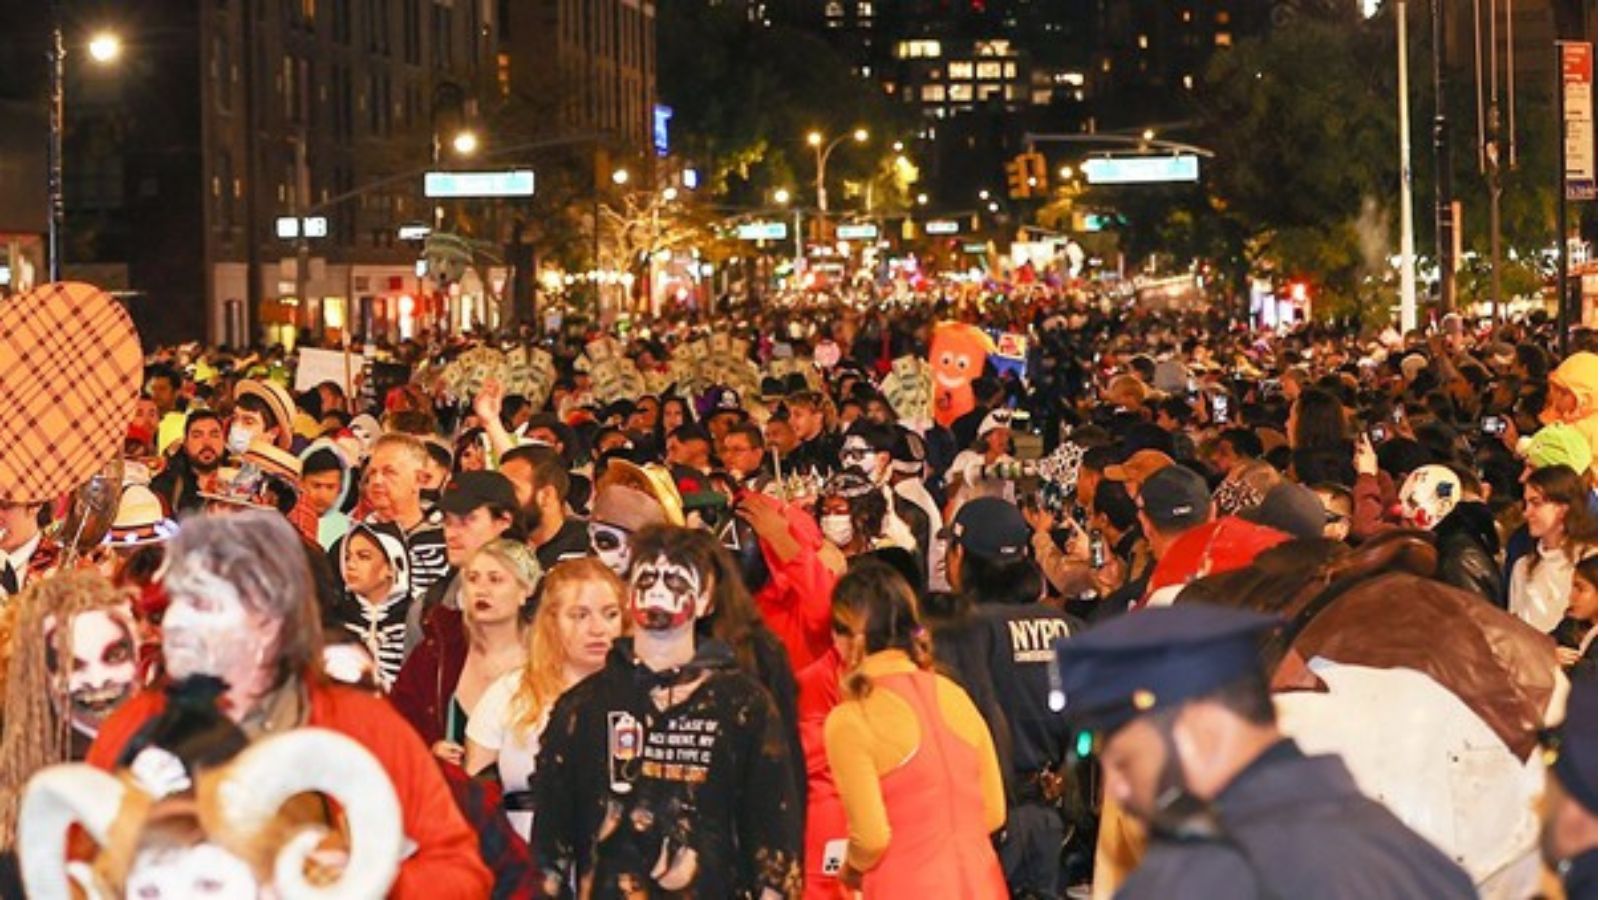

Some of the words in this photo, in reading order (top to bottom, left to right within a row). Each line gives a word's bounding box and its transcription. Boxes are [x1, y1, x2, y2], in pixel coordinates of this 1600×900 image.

[1008, 618, 1069, 649] NYPD
[699, 735, 715, 747] MY
[677, 750, 698, 762] TYPE
